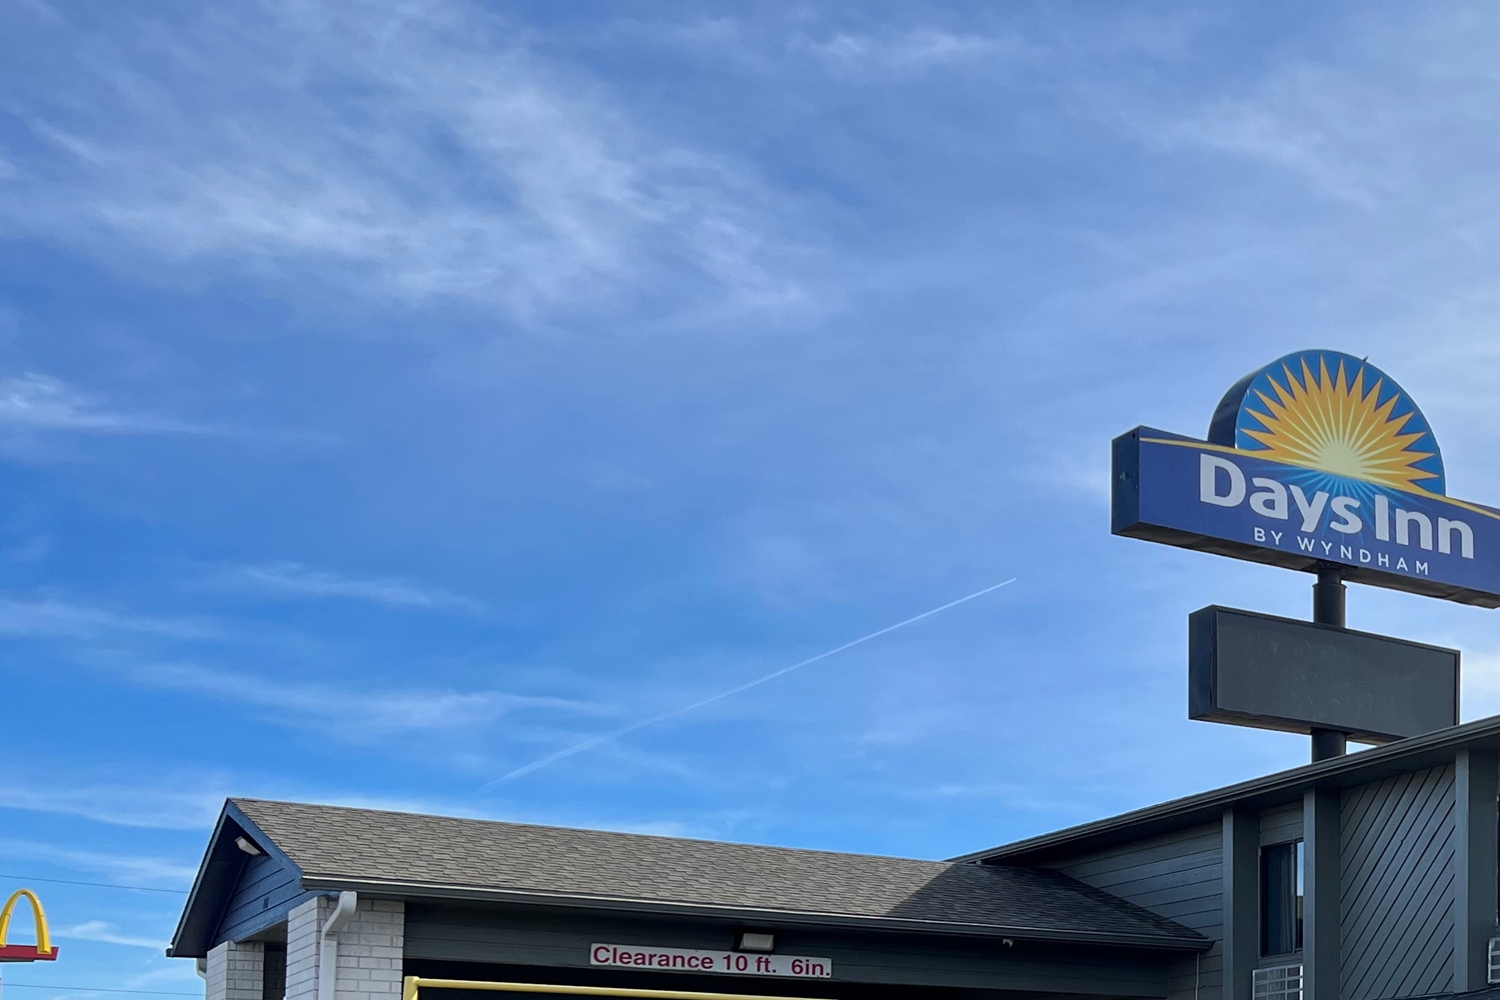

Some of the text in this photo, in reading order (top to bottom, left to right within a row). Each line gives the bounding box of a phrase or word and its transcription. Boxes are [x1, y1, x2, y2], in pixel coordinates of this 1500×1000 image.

[1200, 452, 1475, 560] Days Inn
[1253, 526, 1429, 576] BY WYNDHAM
[592, 946, 831, 977] Clearance 10 ft. 6in.
